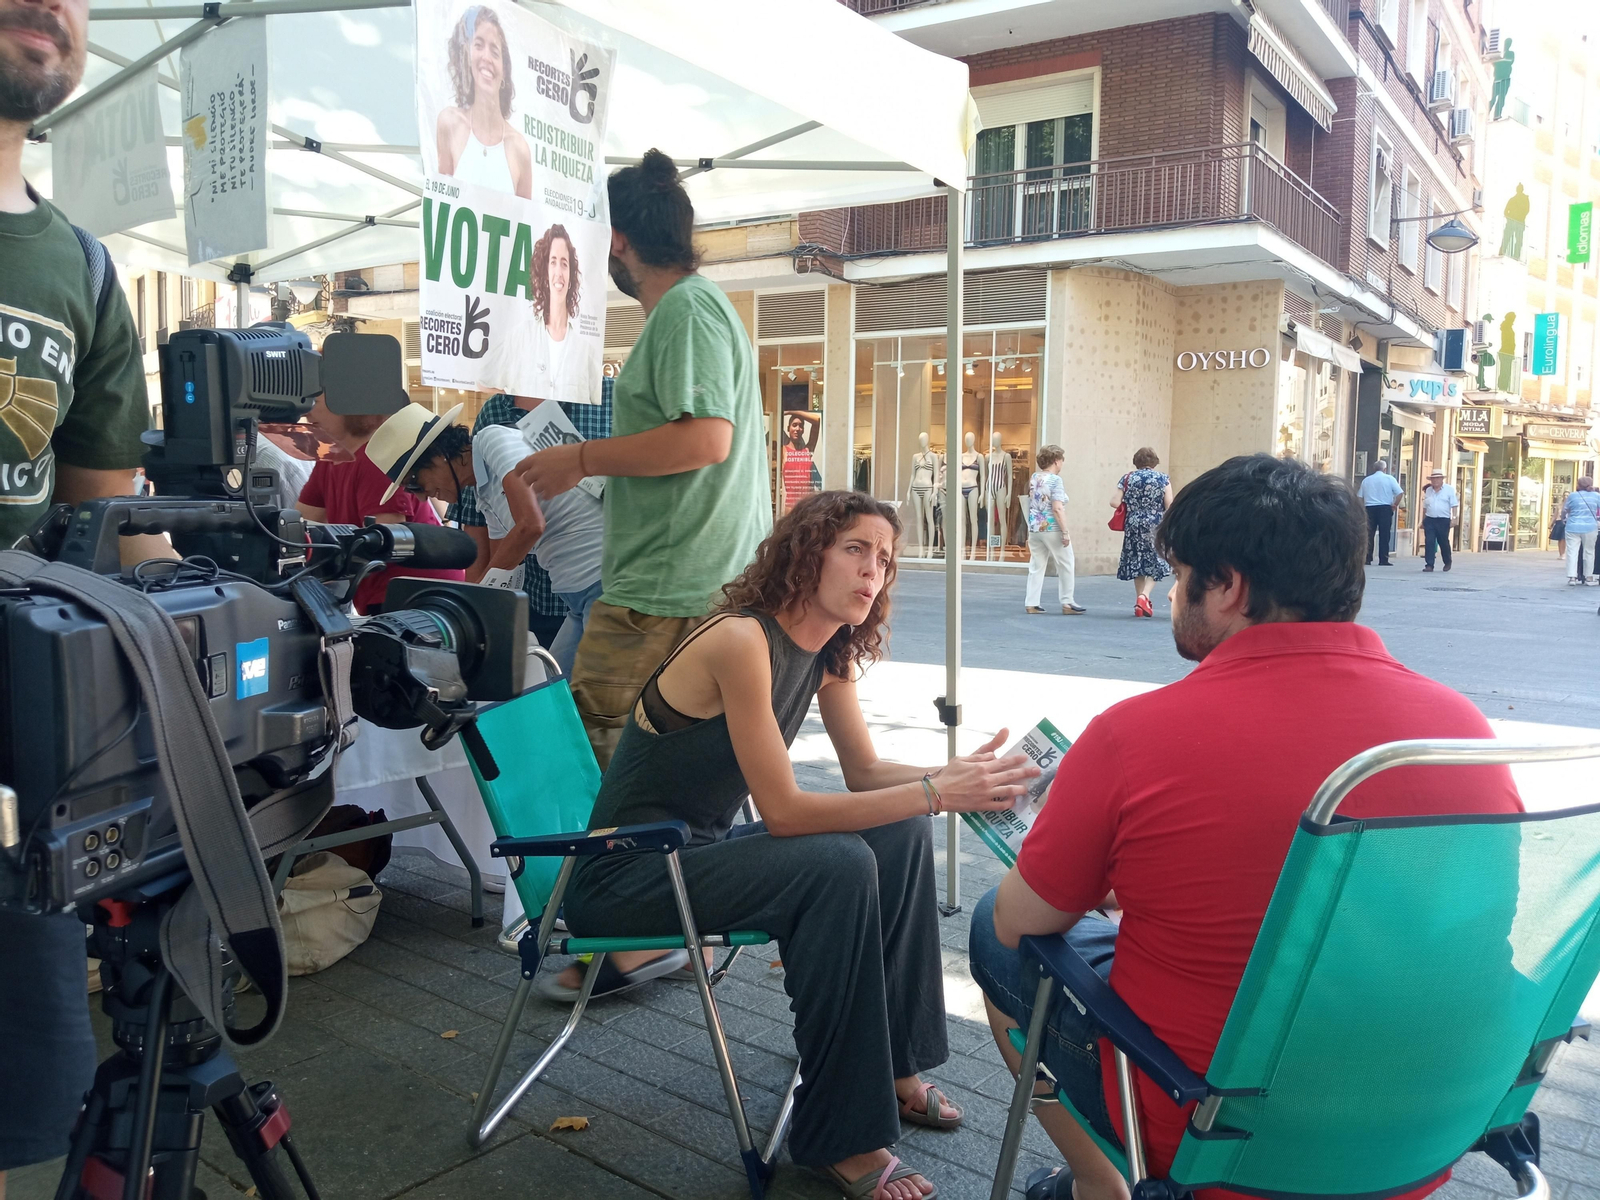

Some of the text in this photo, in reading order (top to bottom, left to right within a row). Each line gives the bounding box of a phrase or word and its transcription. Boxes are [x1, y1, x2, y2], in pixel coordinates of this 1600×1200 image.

[528, 55, 571, 88] RECORTES
[536, 74, 569, 107] CERO
[524, 113, 594, 162] REDISTRIBUIR
[229, 156, 236, 172] TU
[535, 143, 594, 184] LA RIQUEZA
[220, 171, 227, 193] ME
[239, 168, 247, 189] TE
[431, 181, 439, 193] 19
[438, 183, 446, 195] DE
[445, 184, 460, 199] JUNIO
[544, 187, 573, 204] ELECCIONES
[1576, 211, 1590, 255] idiomas
[422, 197, 536, 301] VOTA
[420, 316, 462, 336] RECORTES
[265, 350, 287, 359] SWIT
[426, 333, 461, 357] CERO
[1542, 315, 1557, 374] Eurolingua
[41, 336, 74, 385] EN
[1176, 347, 1271, 372] OYSHO
[1410, 377, 1457, 401] yupis
[1459, 409, 1489, 422] MIA
[1549, 427, 1585, 439] CERVERA
[1021, 743, 1039, 761] CERO
